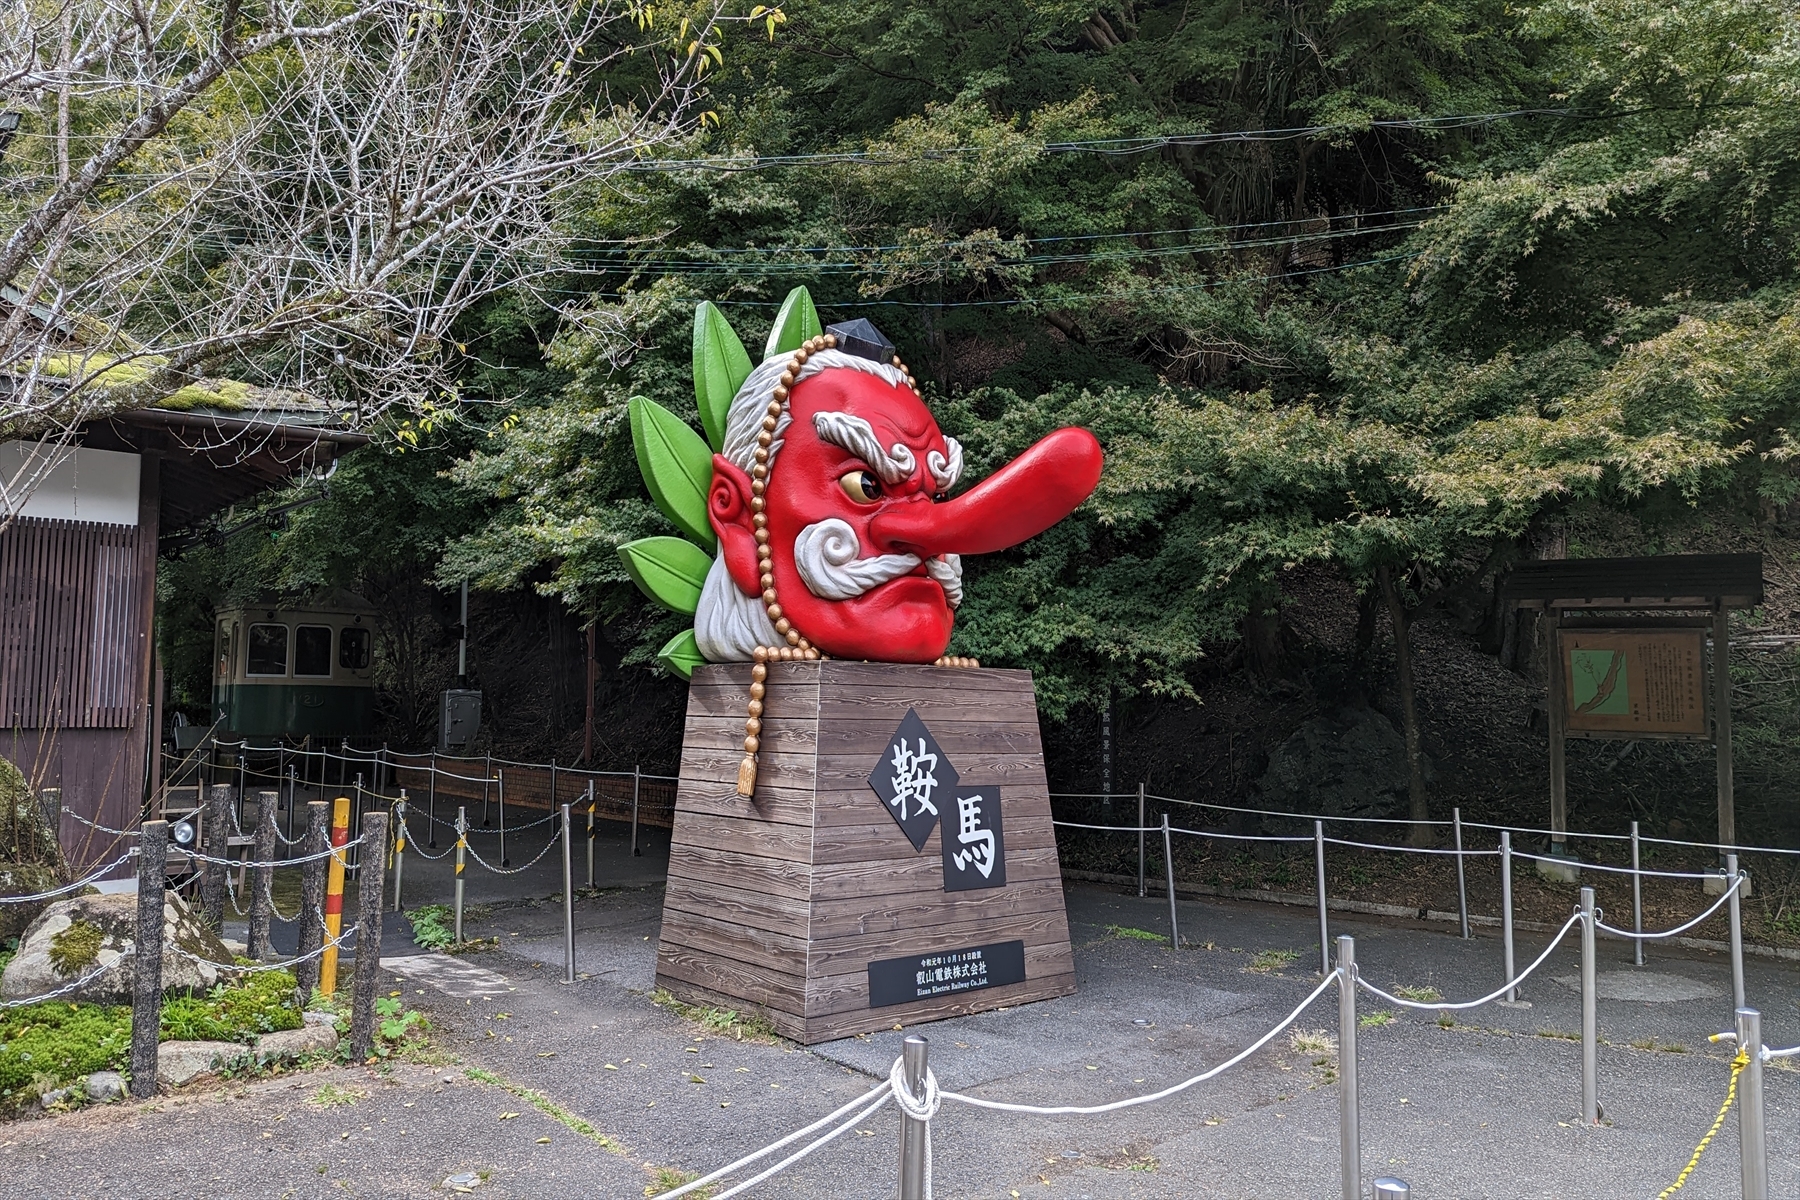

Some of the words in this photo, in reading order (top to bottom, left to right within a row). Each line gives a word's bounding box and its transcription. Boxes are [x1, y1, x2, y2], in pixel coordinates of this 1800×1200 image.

[304, 694, 318, 704] 21
[890, 738, 939, 821] 鞍
[952, 794, 995, 879] 馬
[916, 961, 988, 985] 叡山電鉄株式会社
[917, 987, 931, 996] Eizan
[932, 983, 950, 994] Electric
[951, 981, 970, 991] Railway
[970, 977, 989, 987] Co.,Ltd.
